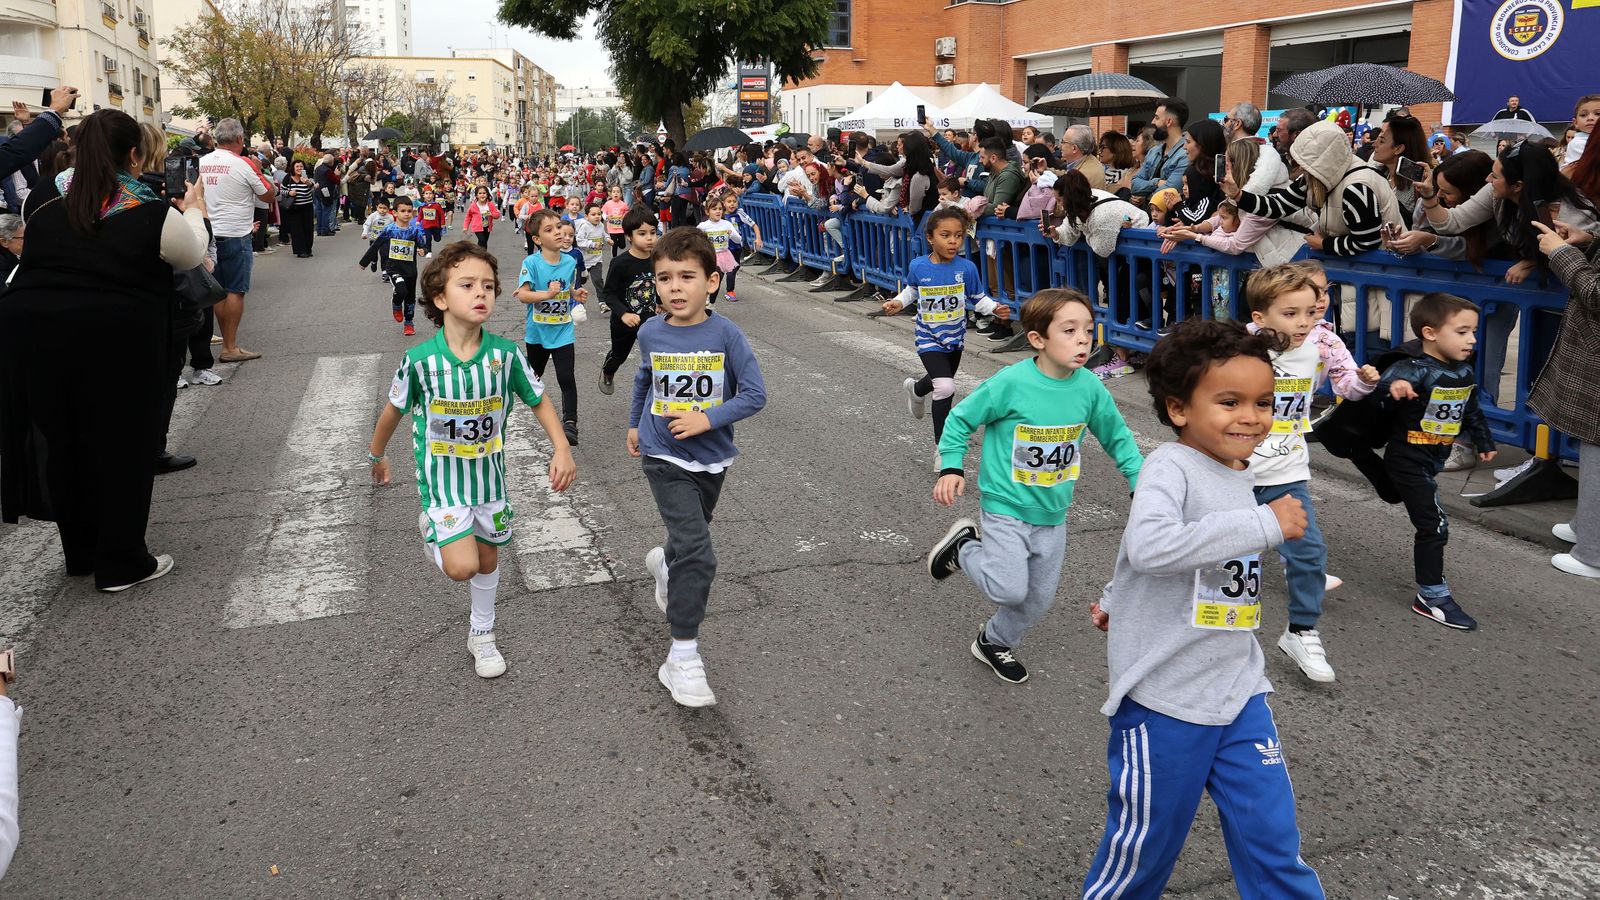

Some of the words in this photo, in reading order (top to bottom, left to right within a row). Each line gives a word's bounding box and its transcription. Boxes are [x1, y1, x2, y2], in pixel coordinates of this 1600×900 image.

[1496, 32, 1519, 56] CONSORCIO
[1545, 0, 1558, 31] PROVINCIA
[838, 119, 865, 129] BOMBEROS
[394, 246, 410, 254] 841
[541, 302, 567, 314] 223
[926, 297, 958, 311] 719
[659, 375, 713, 398] 120
[434, 399, 458, 408] CARRERA
[1435, 404, 1463, 420] 83
[444, 416, 494, 441] 139
[1020, 426, 1044, 435] CARRERA
[1026, 444, 1074, 467] 340
[1221, 560, 1259, 597] 35
